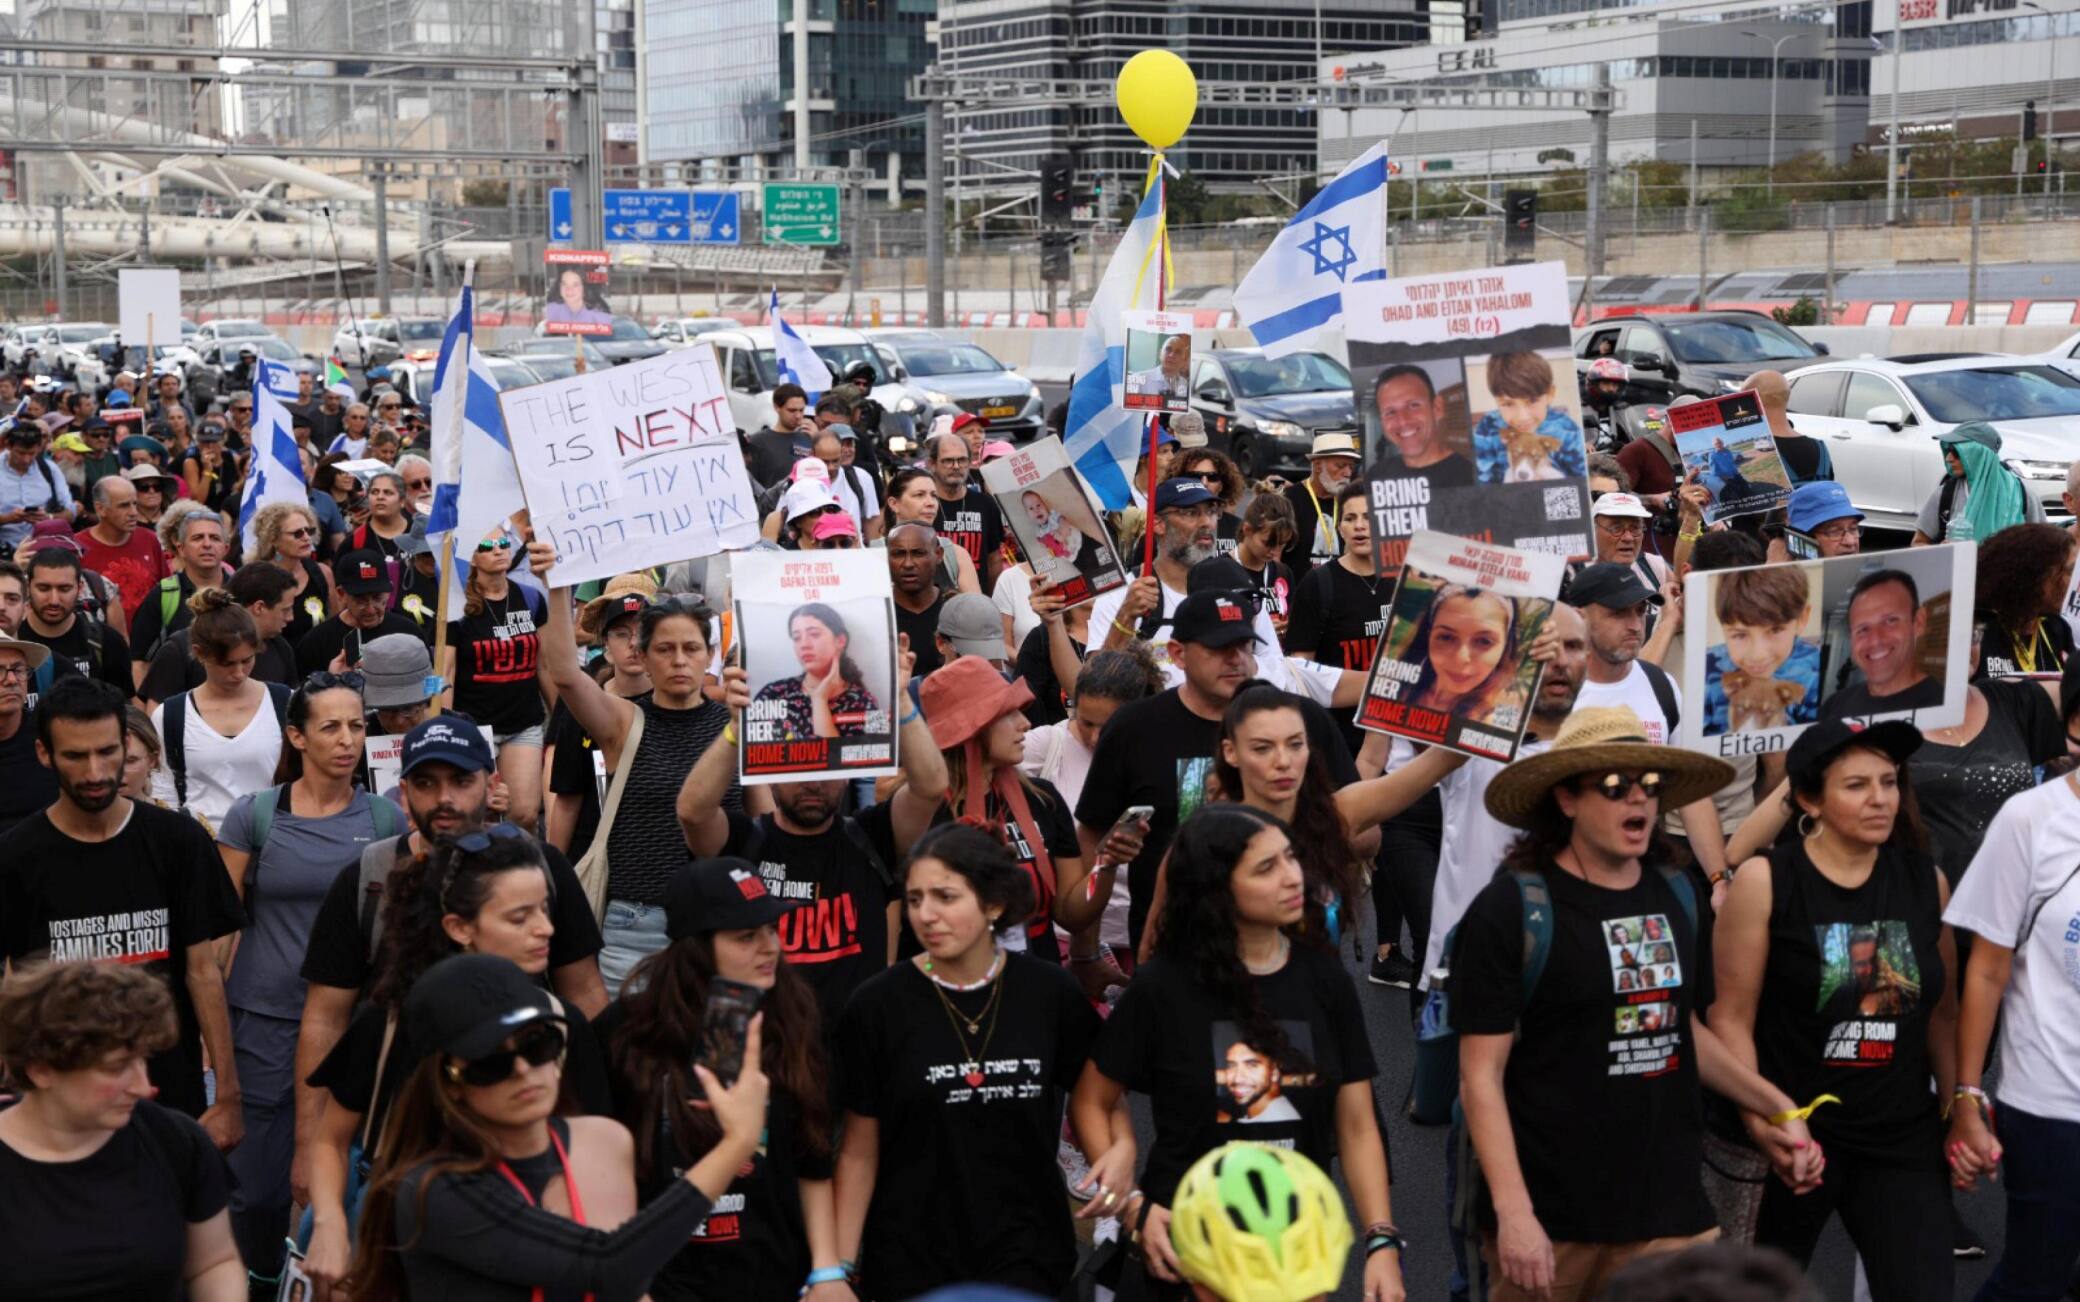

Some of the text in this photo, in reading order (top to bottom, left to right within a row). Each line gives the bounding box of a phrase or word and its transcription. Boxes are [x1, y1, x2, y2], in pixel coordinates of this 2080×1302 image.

[548, 254, 606, 263] KIDNAPPED
[1405, 277, 1504, 302] אוהד ואיתן יהלומי
[1382, 292, 1533, 322] OHAD AND EITAN YAHALOMI
[1446, 315, 1501, 335] (49) (12)
[512, 359, 714, 434] THE WEST
[545, 396, 725, 468] IS NEXT
[627, 464, 679, 495] עוד
[1371, 476, 1431, 508] BRING
[632, 504, 692, 536] עוד
[1374, 506, 1428, 537] THEM
[547, 518, 625, 564] דקה!
[1447, 554, 1479, 572] MORAN
[780, 574, 840, 589] DAFNA ELYAKIM
[472, 633, 537, 673] עכשיו
[1377, 656, 1422, 684] BRING
[1370, 676, 1401, 700] HER
[747, 699, 788, 721] BRING
[1365, 697, 1449, 734] HOME NOW!
[746, 721, 774, 742] HER
[748, 738, 828, 765] HOME NOW!
[1719, 732, 1785, 757] Eitan
[783, 881, 814, 899] HOME
[107, 913, 131, 932] AND
[777, 892, 857, 952] OW!
[126, 926, 169, 956] FORU
[1863, 1021, 1896, 1041] ROMI
[925, 1064, 956, 1084] כאן.
[985, 1059, 1019, 1074] שאת
[1022, 1058, 1040, 1075] עד
[945, 1089, 973, 1104] שם.
